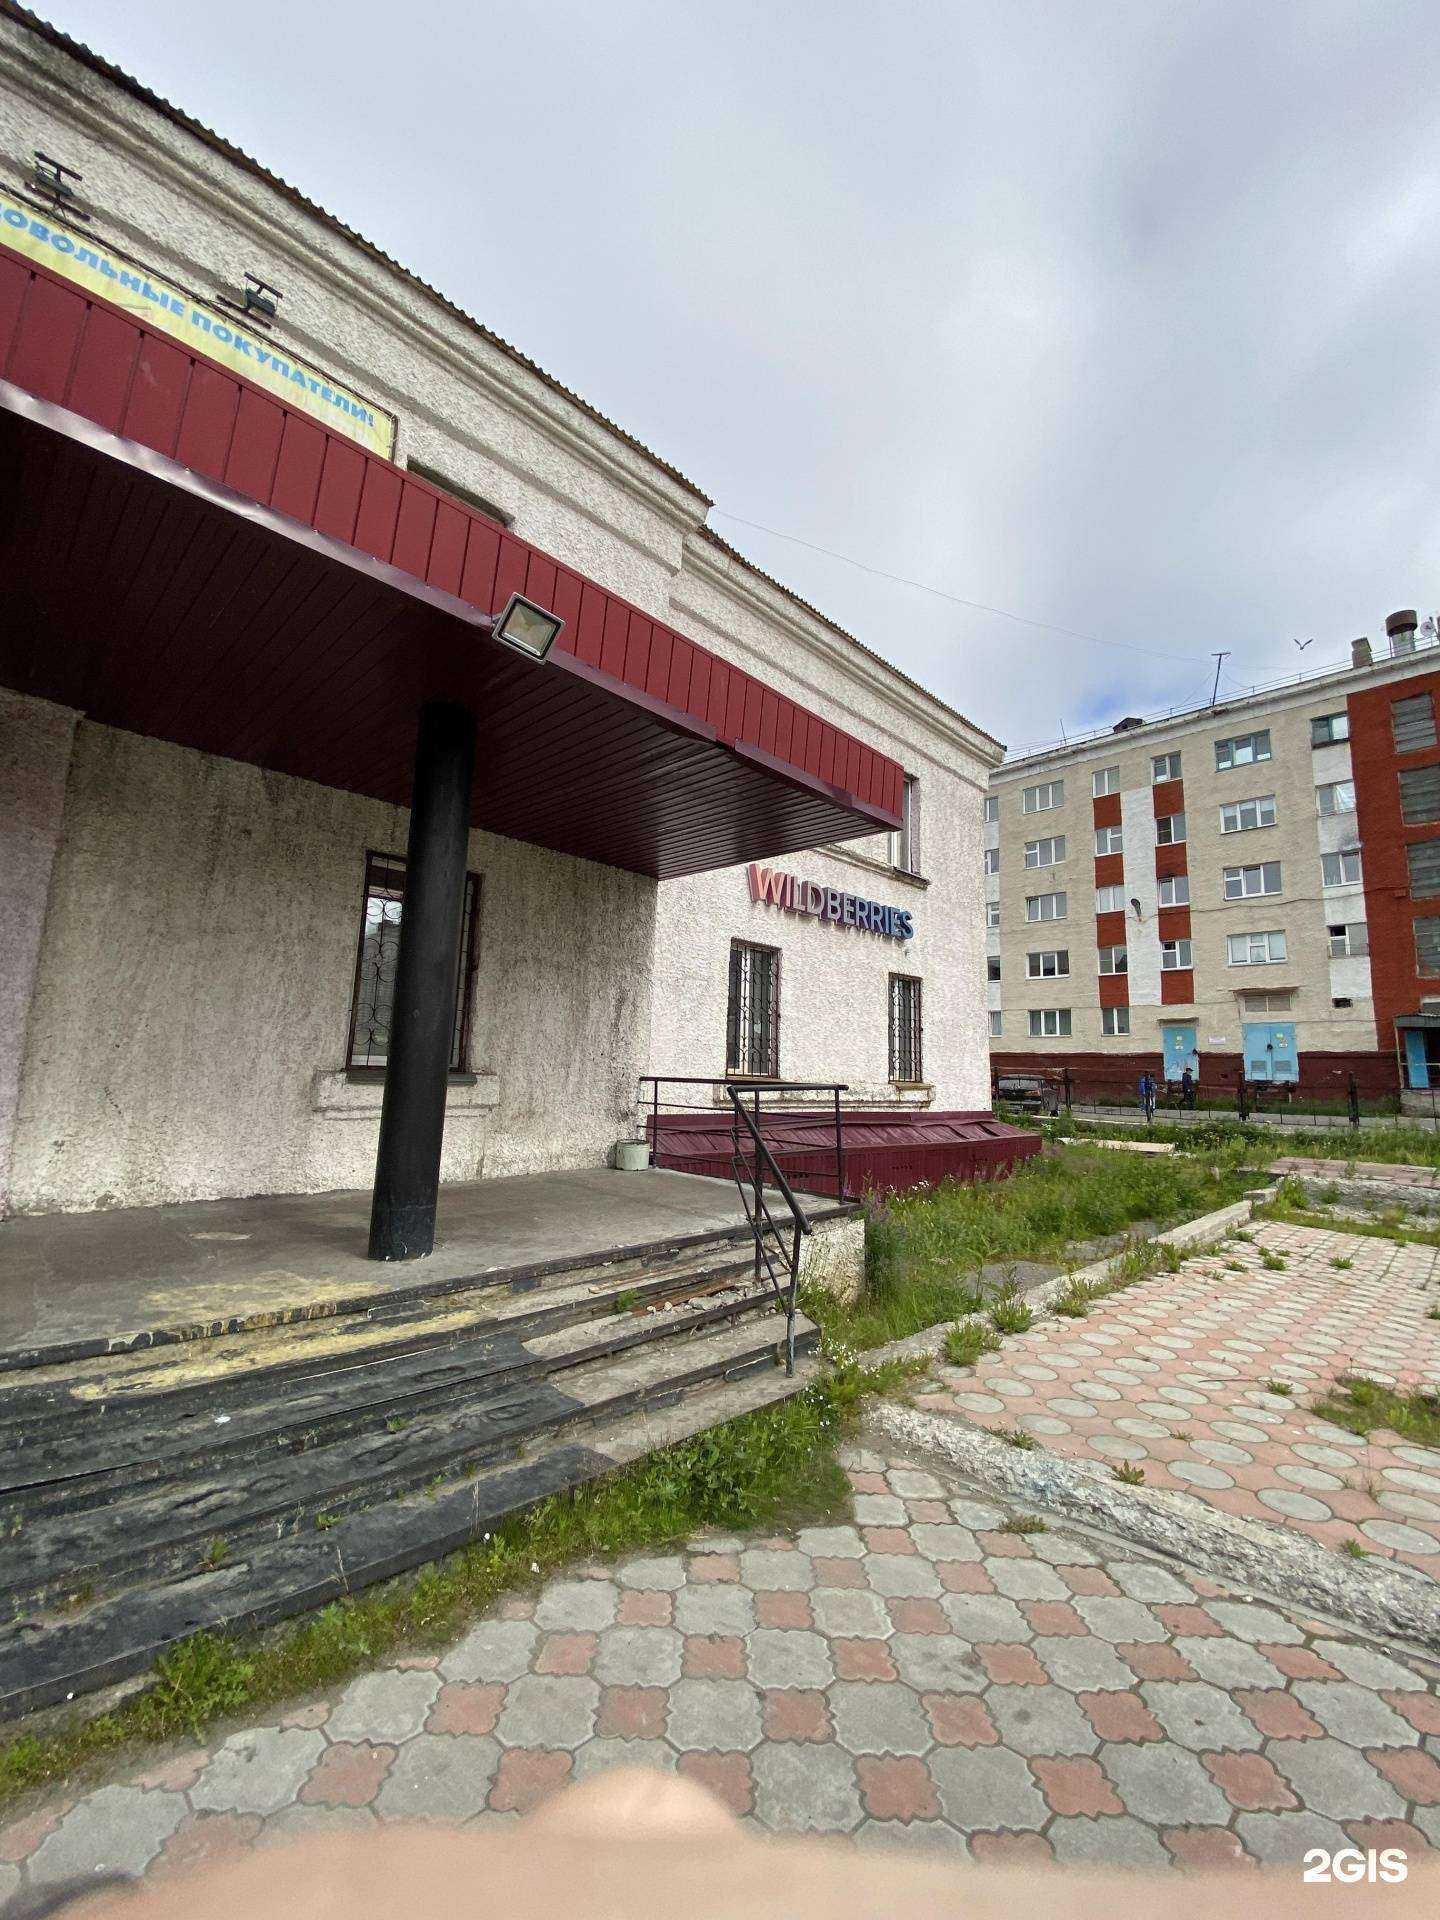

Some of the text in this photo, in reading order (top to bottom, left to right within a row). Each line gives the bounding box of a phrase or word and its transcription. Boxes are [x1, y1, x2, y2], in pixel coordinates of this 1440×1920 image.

[0, 203, 375, 427] ОВОЛЬНЫЕ ПОКУПАТЕЛИ!
[748, 863, 914, 939] WILDBERRIES
